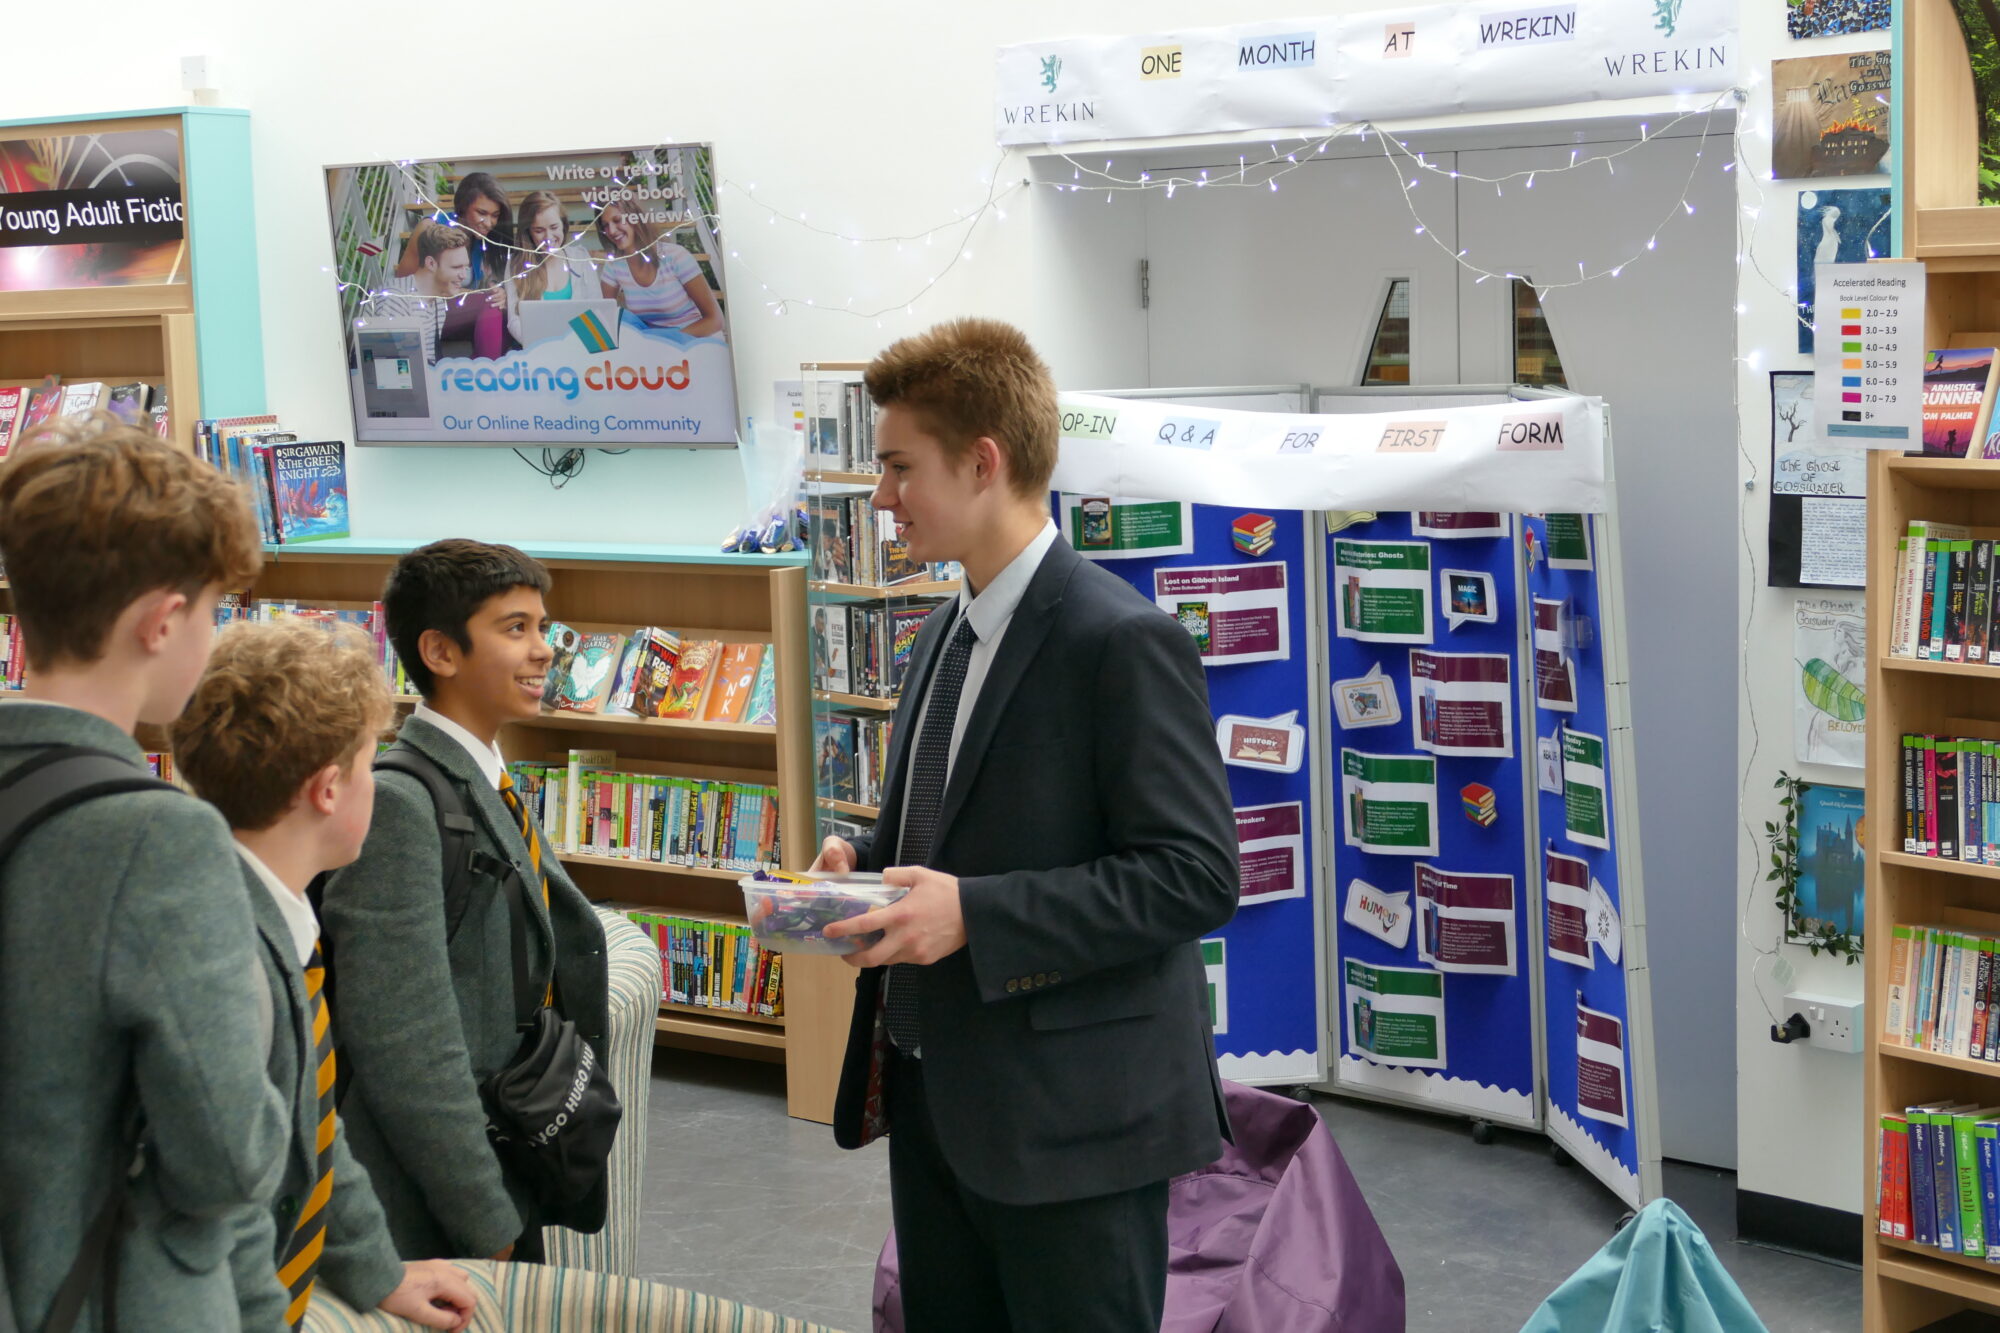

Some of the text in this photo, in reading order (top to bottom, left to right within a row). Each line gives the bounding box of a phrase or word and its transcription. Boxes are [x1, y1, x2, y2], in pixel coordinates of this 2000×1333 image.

[1141, 11, 1576, 75] ONE MONTH AT WREKIN!
[1604, 46, 1725, 77] WREKIN
[1875, 53, 1891, 65] Gh
[1003, 101, 1095, 124] WREKIN
[545, 159, 683, 182] Write or record
[582, 184, 686, 202] video book
[66, 201, 123, 227] Adult
[621, 209, 693, 225] reviews
[1833, 278, 1906, 288] Accelerated Reading
[1839, 294, 1899, 303] Book Level Colour Key
[1866, 309, 1897, 317] 2.0 2.9
[1865, 326, 1897, 335] 3.0 3.9
[1865, 343, 1897, 352] 4.0 4.9
[1865, 360, 1897, 369] 5.0 5.9
[440, 358, 690, 400] reading cloud
[1865, 377, 1897, 386] 6.0 6.9
[1931, 383, 1977, 392] ARMISTICE
[1865, 394, 1897, 403] 7.0 7.9
[1923, 412, 1973, 420] OM PALMER
[443, 414, 702, 435] Our Online Reading Community
[1158, 423, 1177, 444] Q
[1181, 425, 1195, 443] &
[1200, 428, 1215, 446] A
[1280, 432, 1320, 450] FOR
[1378, 428, 1445, 448] FIRST
[1498, 422, 1563, 445] FORM
[282, 444, 340, 458] SIR GAWAIN
[304, 455, 340, 467] GREEN
[279, 467, 319, 480] KNIGHT
[1377, 551, 1404, 559] Ghosts
[1164, 577, 1180, 585] Lost
[1191, 576, 1217, 584] Gibbon
[1458, 584, 1477, 593] MAGIC
[1243, 737, 1277, 747] HISTORY
[632, 797, 640, 825] FURIOUS
[1235, 816, 1265, 825] Breakers
[1442, 882, 1458, 890] Time
[1978, 951, 1988, 991] JACKSON
[565, 1069, 588, 1113] HUGO
[581, 1043, 595, 1071] HU
